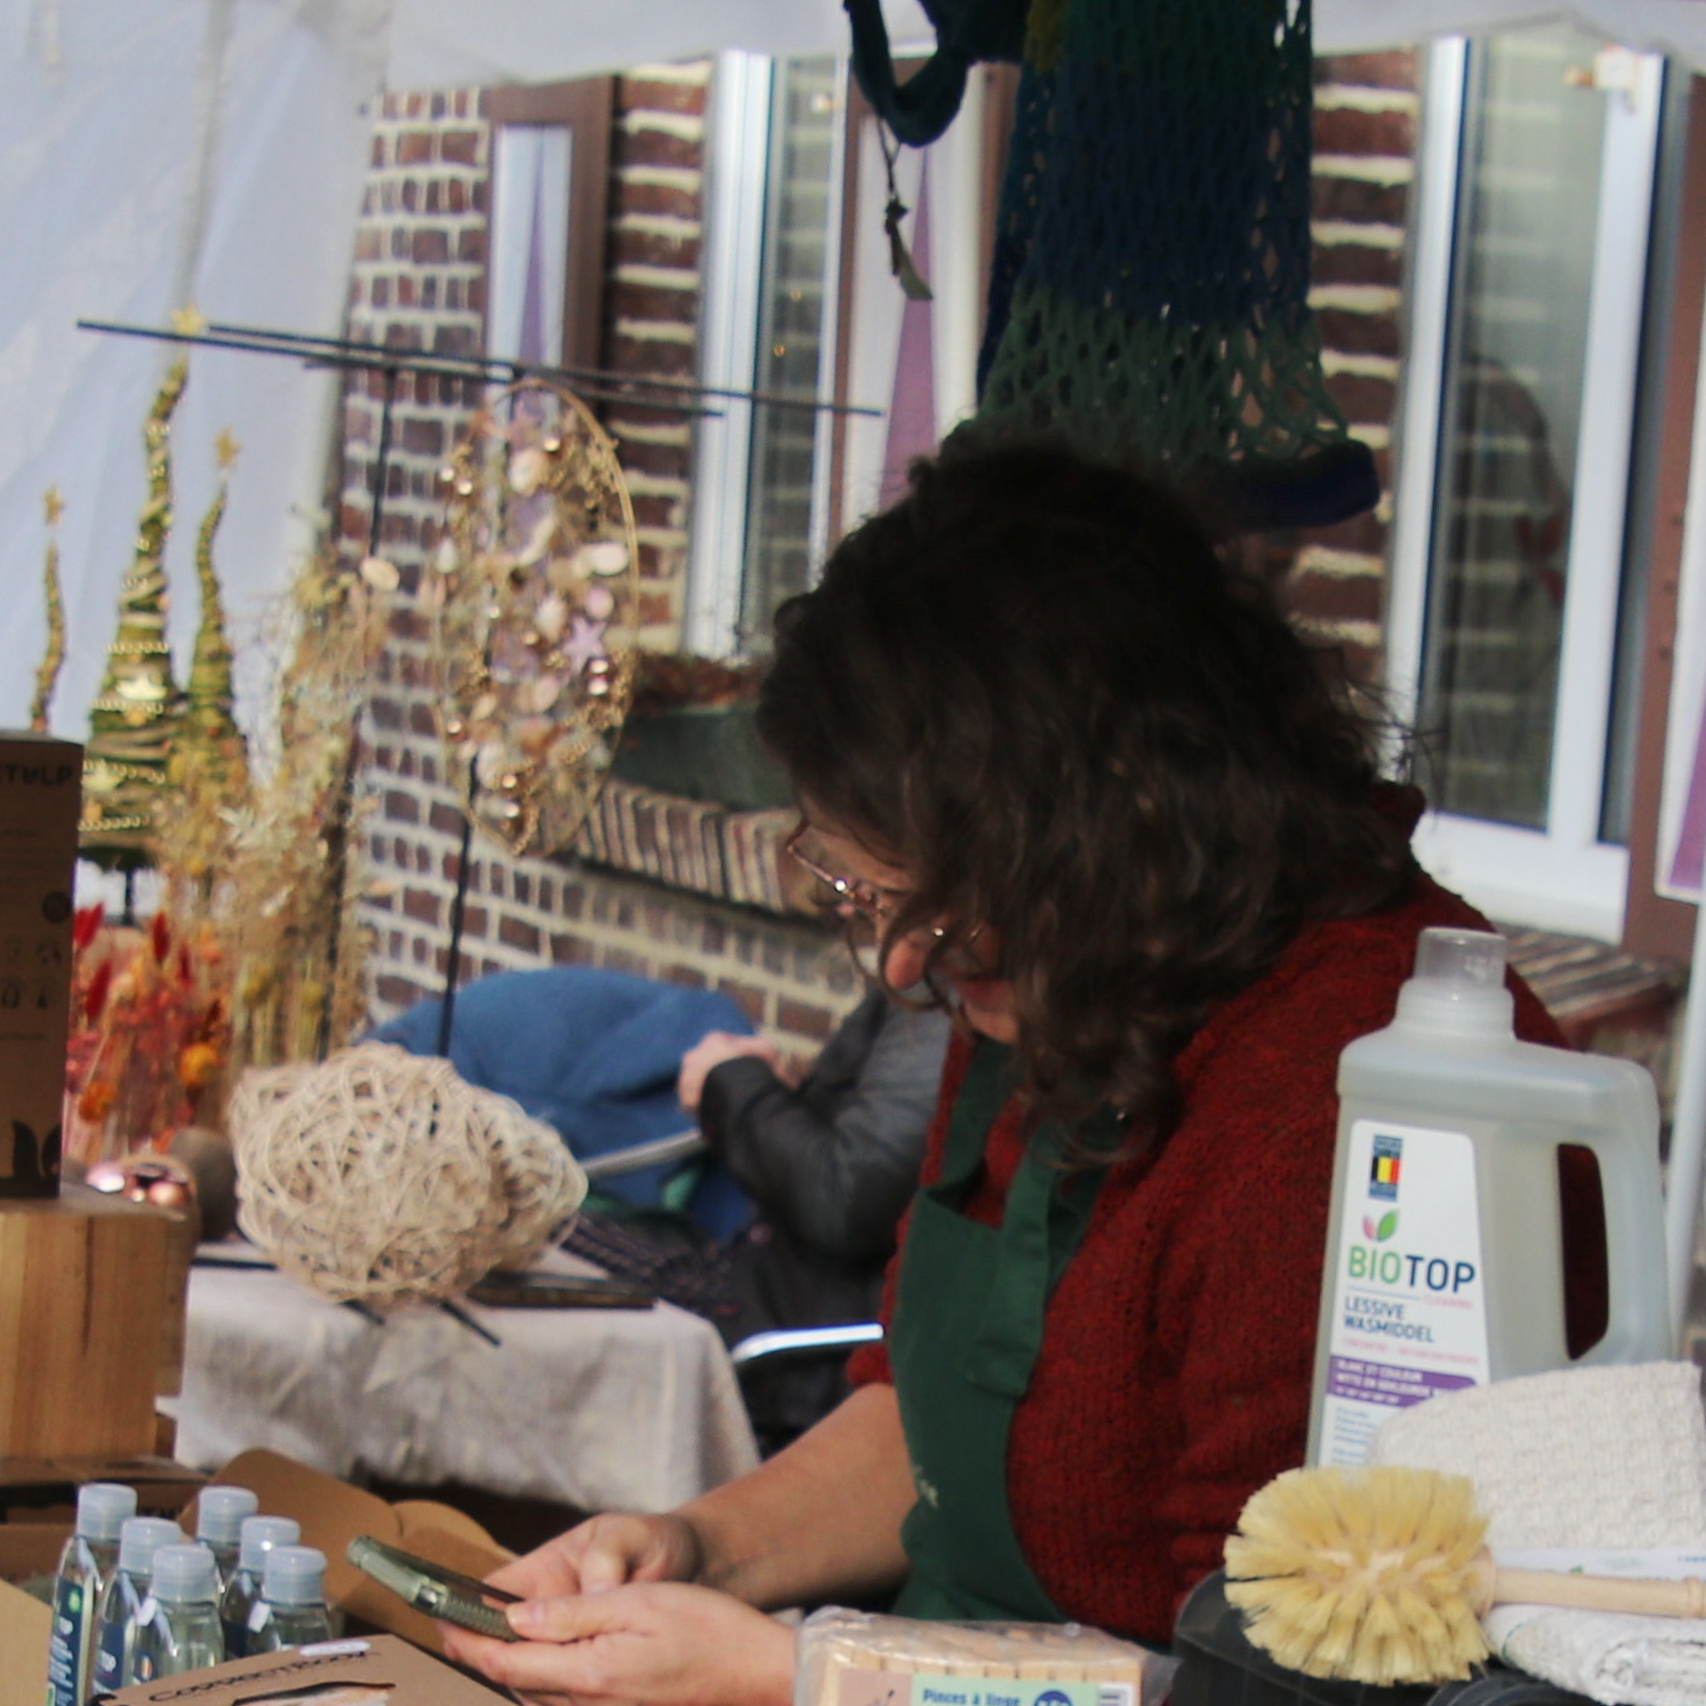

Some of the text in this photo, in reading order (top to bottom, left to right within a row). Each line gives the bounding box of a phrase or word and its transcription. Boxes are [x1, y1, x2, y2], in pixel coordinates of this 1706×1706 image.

[1349, 1246, 1475, 1293] BIOTOP
[1345, 1297, 1405, 1320] LESSIVE
[1344, 1316, 1434, 1344] WASMIDDEL
[922, 1688, 966, 1704] Pinces
[972, 1691, 981, 1706] à
